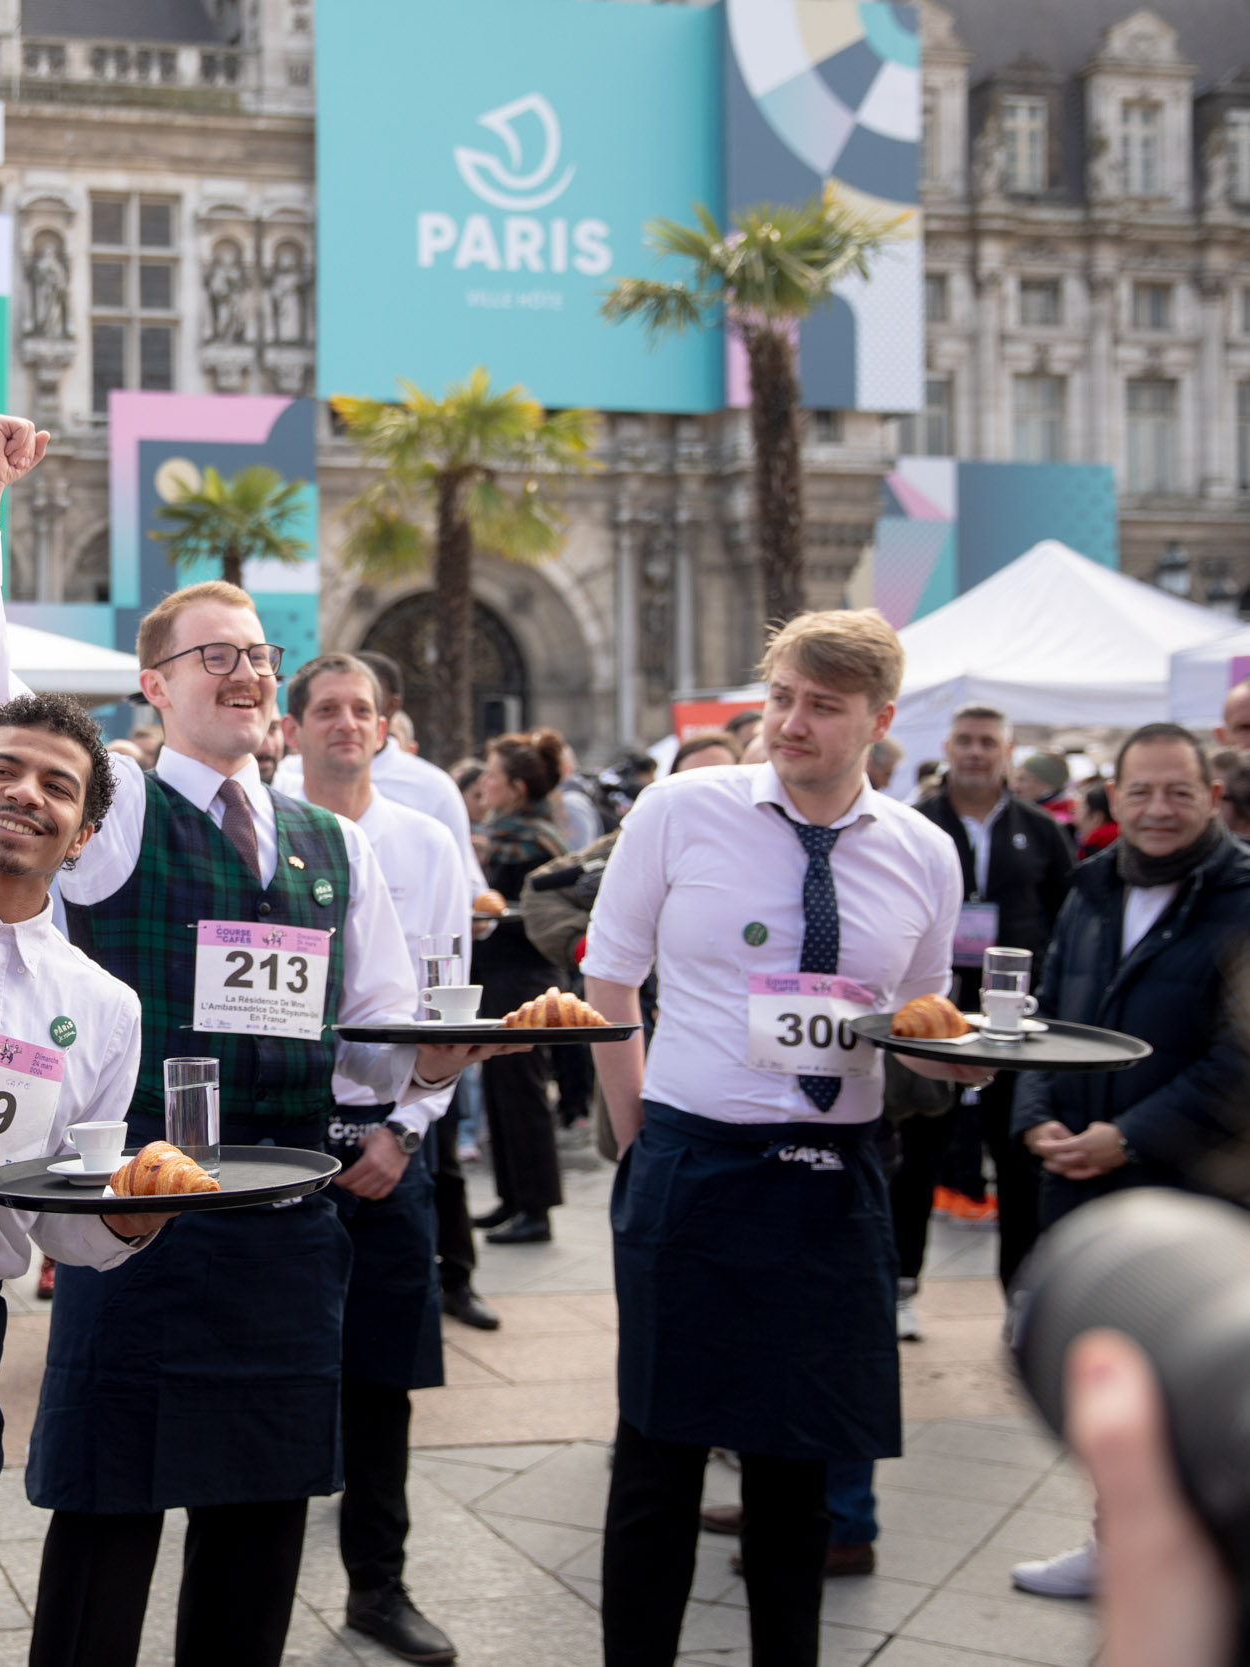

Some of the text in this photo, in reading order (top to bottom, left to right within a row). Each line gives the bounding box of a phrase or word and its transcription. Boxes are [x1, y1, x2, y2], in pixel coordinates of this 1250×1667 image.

[417, 211, 614, 275] PARIS
[216, 928, 251, 937] COURSE
[223, 950, 309, 994] 213
[225, 995, 236, 1003] La
[238, 995, 279, 1006] Résidence
[280, 999, 290, 1007] De
[201, 1002, 267, 1014] L'Ambassadrice
[269, 1006, 278, 1015] Du
[250, 1014, 287, 1024] En France
[776, 1013, 857, 1051] 300
[34, 1052, 59, 1064] Dimanche
[32, 1059, 53, 1071] 24 mars
[30, 1067, 43, 1076] 2024
